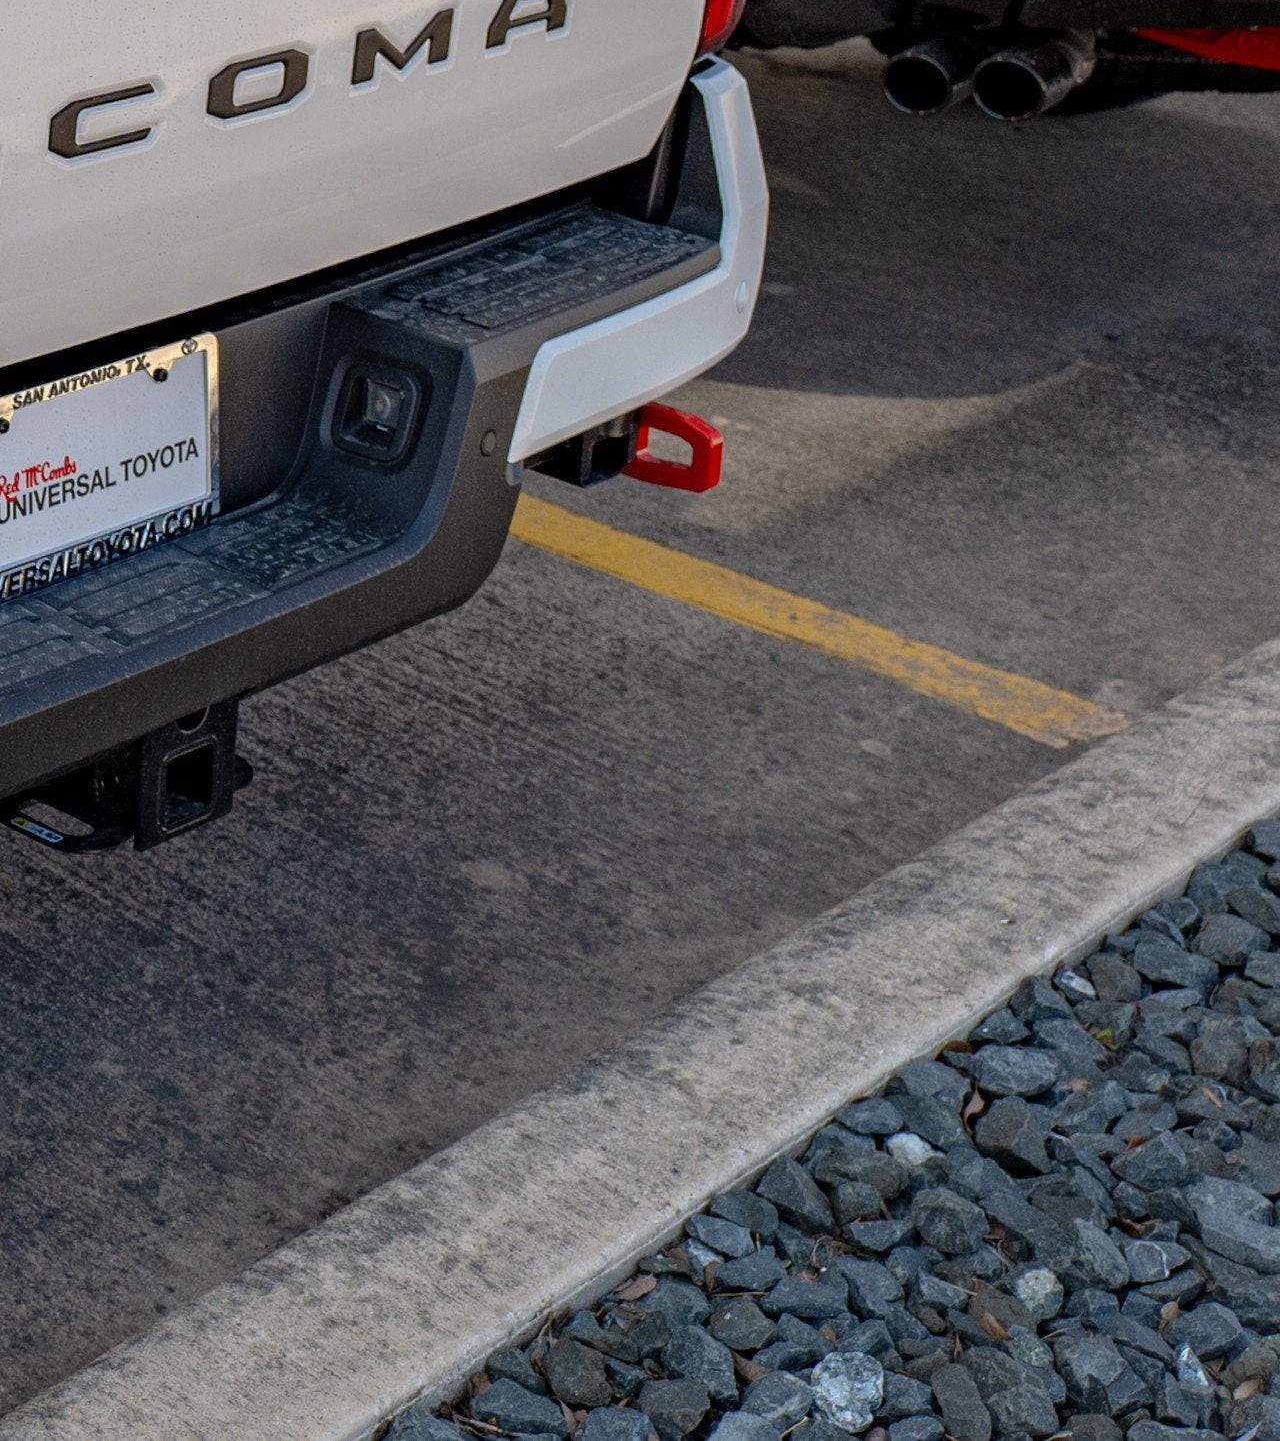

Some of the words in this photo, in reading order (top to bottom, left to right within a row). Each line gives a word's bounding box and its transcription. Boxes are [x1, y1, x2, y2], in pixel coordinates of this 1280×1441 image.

[12, 386, 44, 410] SAN
[48, 364, 121, 398] ANTONIO,
[22, 456, 77, 489] McCombs
[120, 437, 199, 482] TOYOTA
